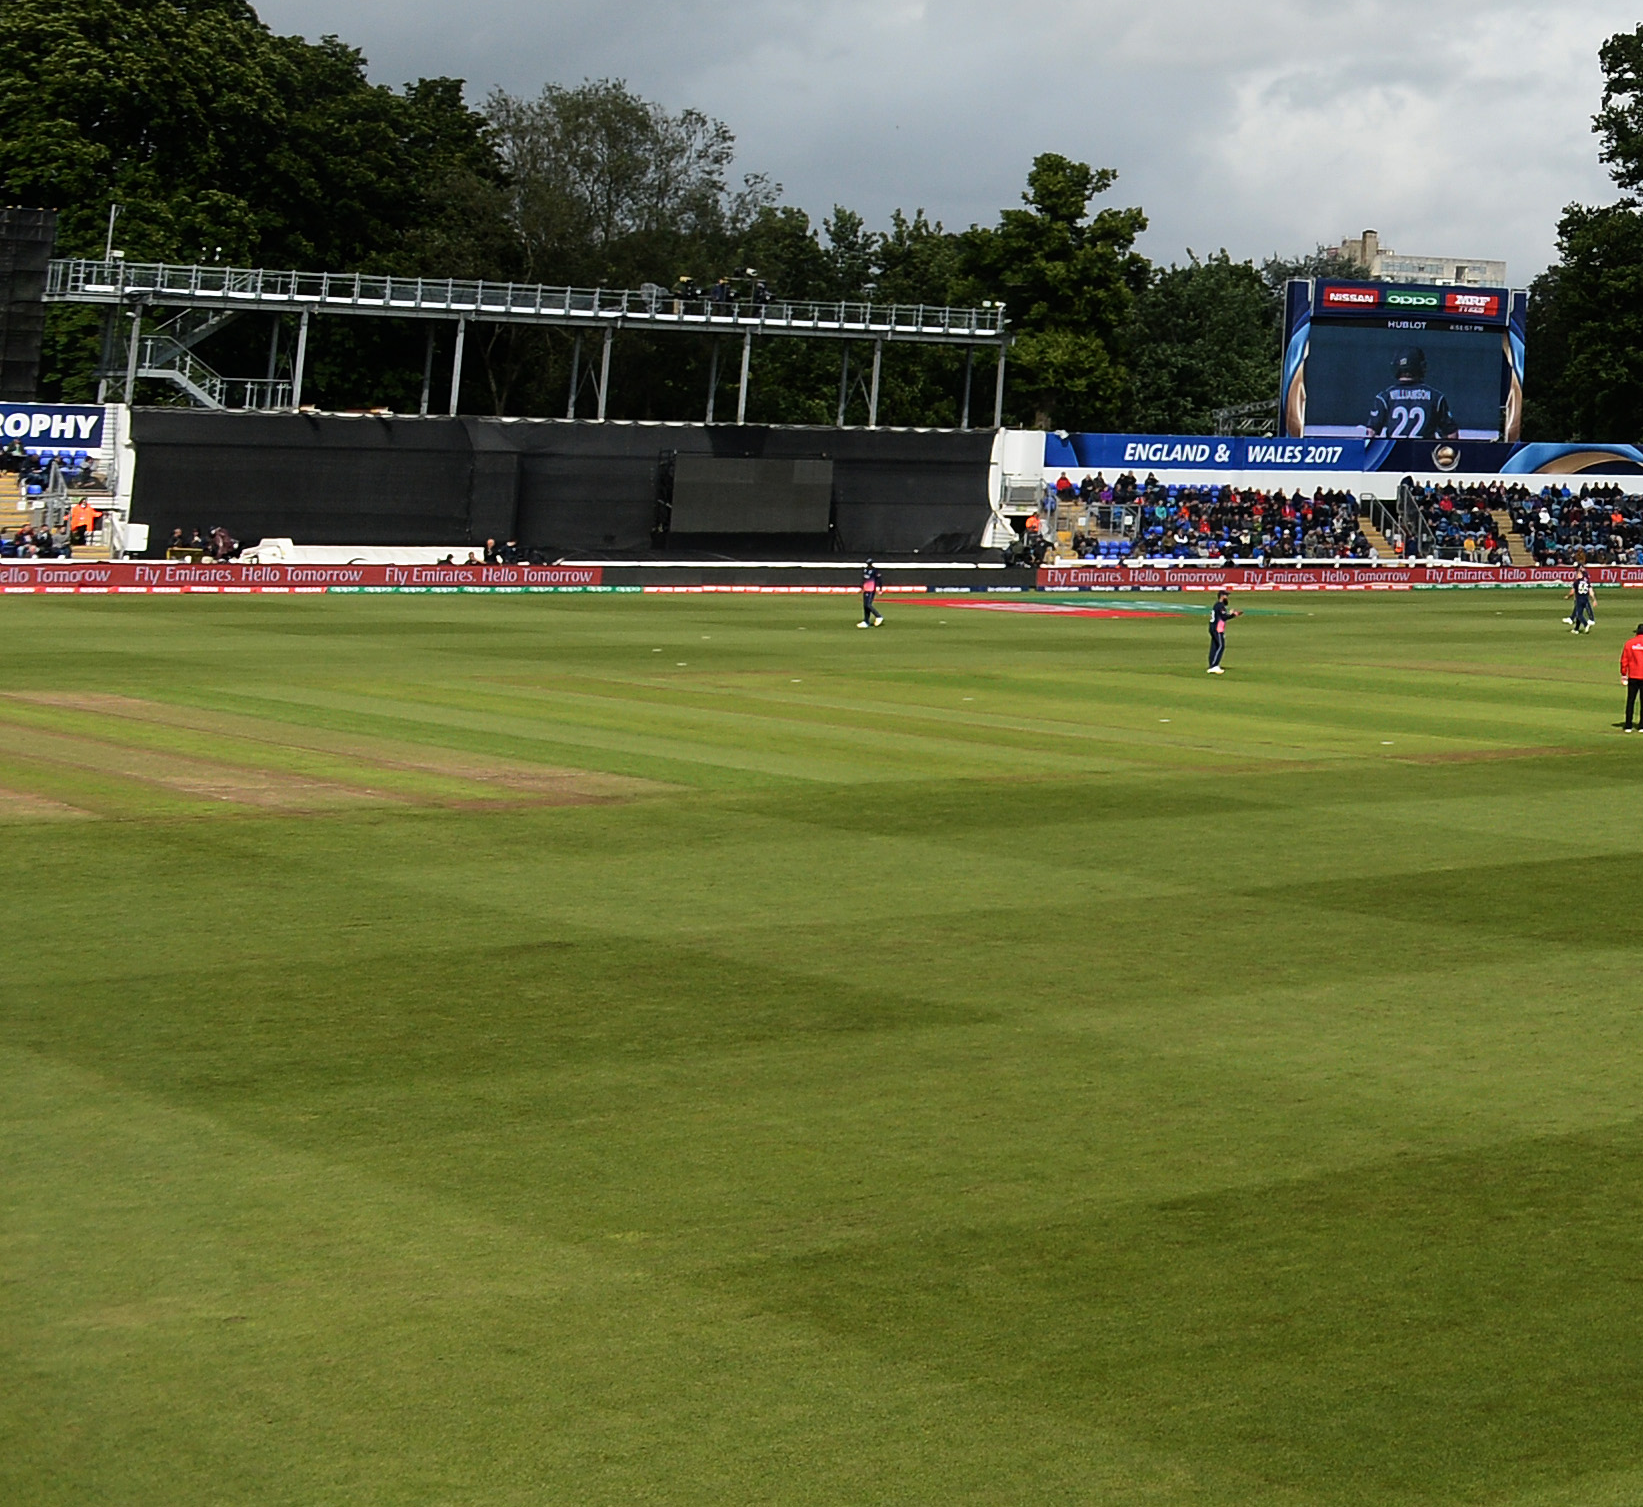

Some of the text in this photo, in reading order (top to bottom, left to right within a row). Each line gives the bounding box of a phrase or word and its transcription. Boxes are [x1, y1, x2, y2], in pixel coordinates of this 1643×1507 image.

[1329, 292, 1374, 303] NISSAN
[1388, 295, 1437, 306] oppo
[1455, 295, 1491, 306] MRF
[1387, 321, 1427, 330] HUBLOT
[0, 413, 99, 439] OPHY
[1392, 406, 1425, 438] 22
[1124, 443, 1343, 464] ENGLAND & WALES 2017
[0, 567, 110, 583] ello Tomorrow
[135, 567, 160, 585] Fly
[242, 567, 280, 581] Hello
[285, 567, 362, 581] Tomorrow
[386, 568, 408, 585] Fly
[483, 568, 517, 582] Hello
[522, 568, 592, 582] Tomorrow
[1048, 570, 1067, 585] Fly
[1130, 570, 1159, 582] Hello
[1164, 570, 1225, 582] Tomorrow
[1244, 570, 1262, 585] Fly
[1322, 571, 1349, 582] Hello
[1354, 570, 1410, 582] Tomorrow
[1426, 570, 1443, 584] Fly
[1499, 569, 1527, 581] Hello
[1532, 569, 1576, 581] Tomorro
[1601, 569, 1617, 584] Fly
